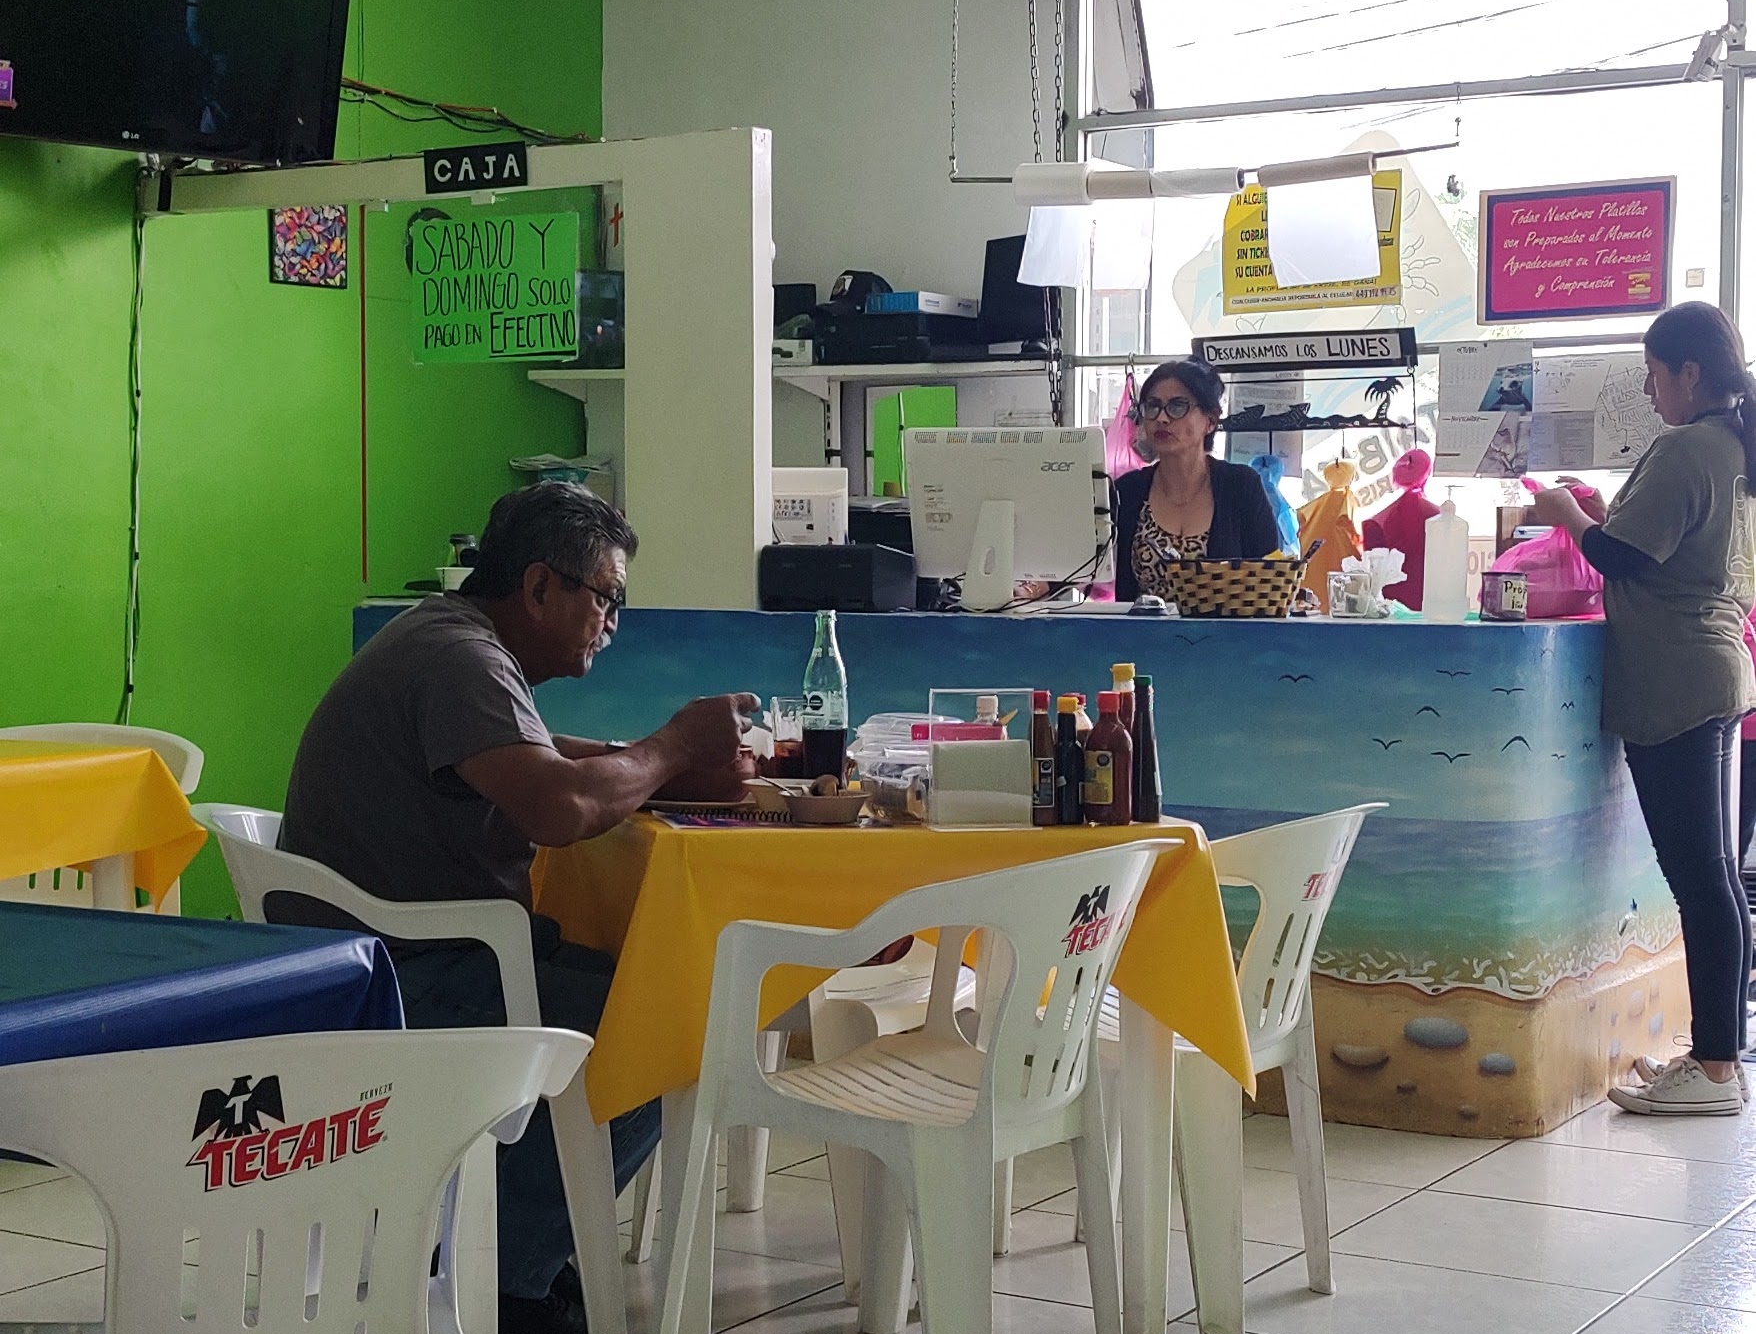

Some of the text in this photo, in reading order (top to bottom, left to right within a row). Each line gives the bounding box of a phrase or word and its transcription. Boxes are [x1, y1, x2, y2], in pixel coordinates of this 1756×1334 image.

[433, 153, 521, 183] CAJA
[1510, 200, 1648, 227] Todos Nuestros Platillos
[416, 218, 555, 275] SABADO Y
[1524, 229, 1585, 251] Preparados
[1589, 227, 1605, 242] al
[1604, 225, 1652, 242] Momento
[1245, 265, 1273, 278] CUENTA
[1503, 254, 1571, 276] Agradecemos
[1595, 249, 1651, 266] Tolerancia
[423, 272, 571, 317] DOMINGO SOLO
[425, 309, 577, 354] PAGO EN EFECTIVO
[1206, 337, 1391, 361] DESCANSAMOS LOS LUNES
[1040, 461, 1075, 472] acer
[185, 1096, 392, 1192] TECATE
